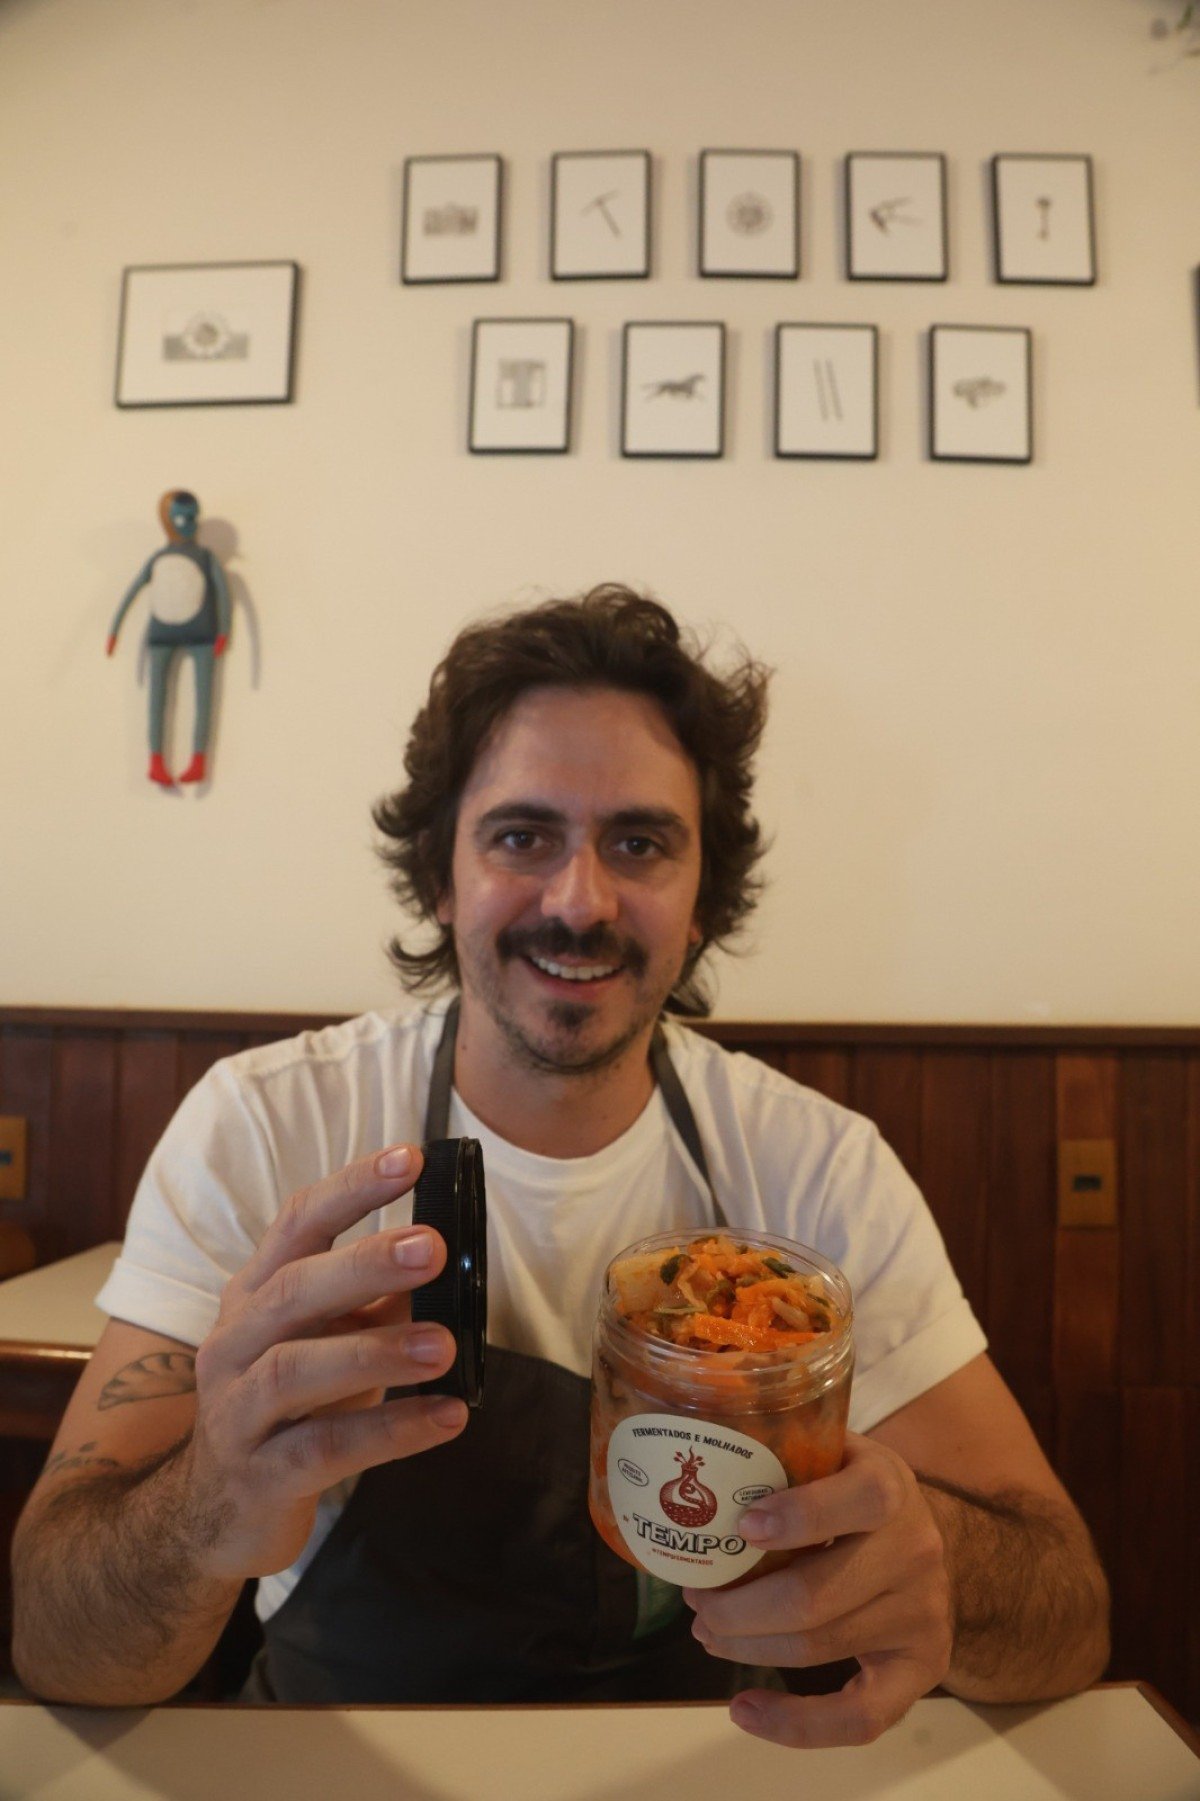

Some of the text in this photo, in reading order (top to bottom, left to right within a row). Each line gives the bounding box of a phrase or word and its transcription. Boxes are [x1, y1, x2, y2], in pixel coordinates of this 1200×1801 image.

[632, 1428, 753, 1459] FERMENTADOS E MOLHADOS
[633, 1513, 746, 1555] TEMPO
